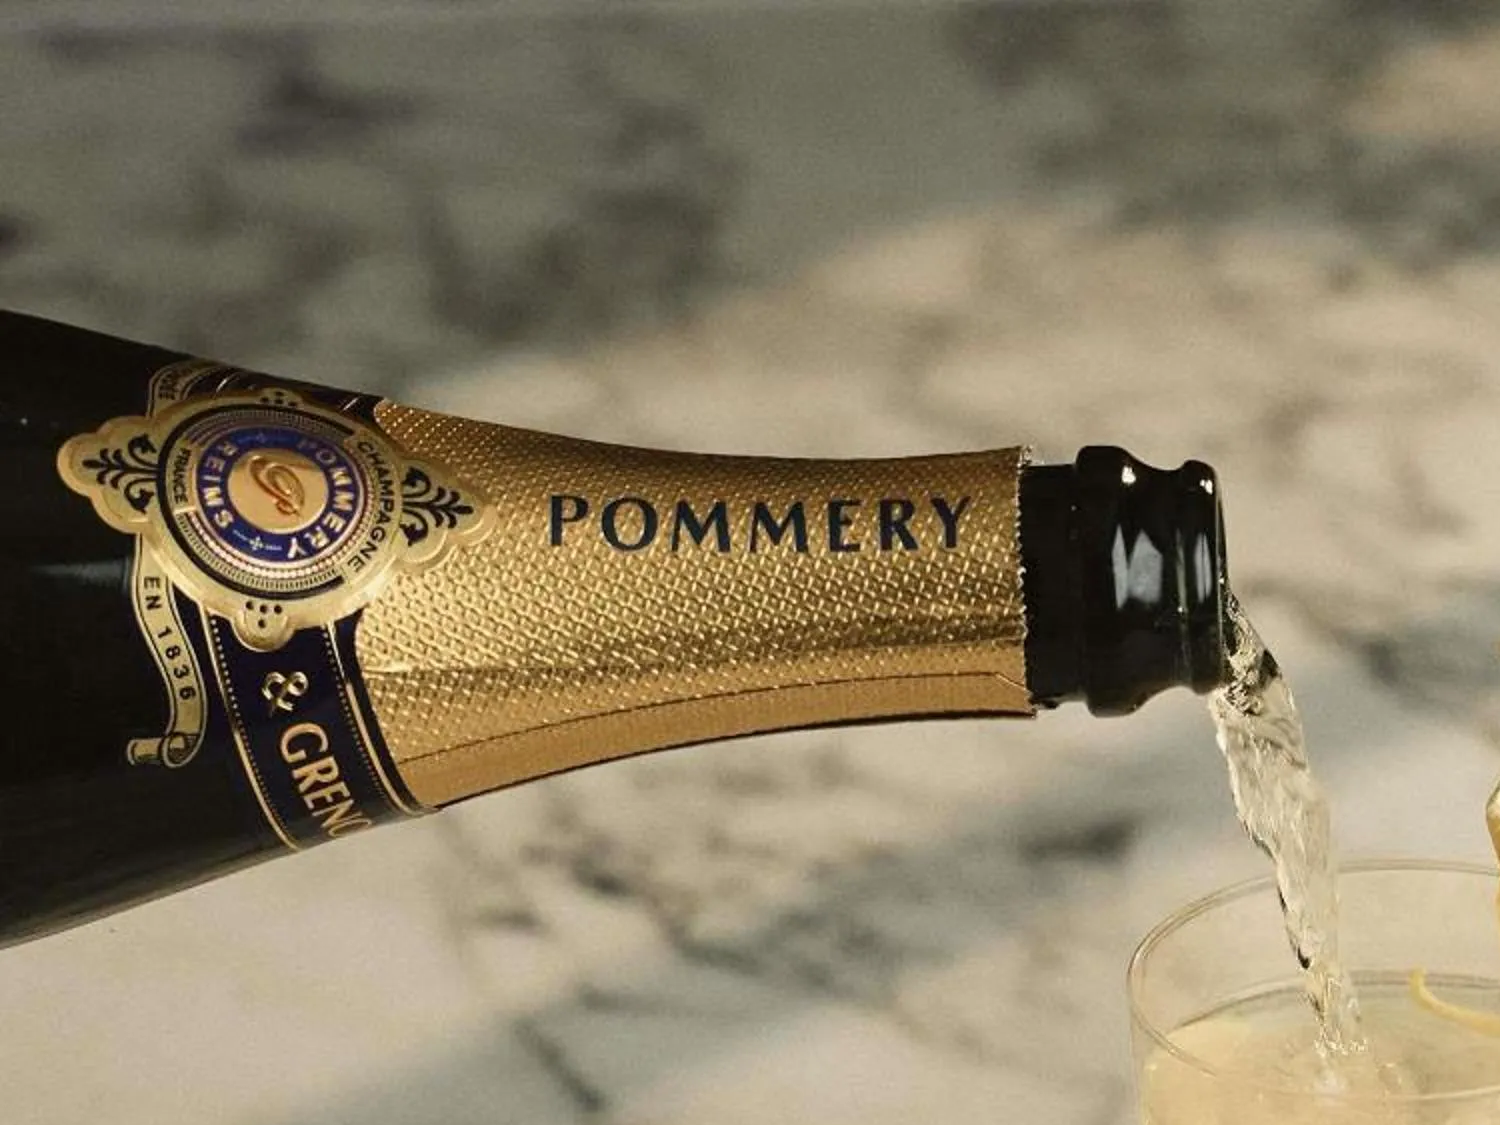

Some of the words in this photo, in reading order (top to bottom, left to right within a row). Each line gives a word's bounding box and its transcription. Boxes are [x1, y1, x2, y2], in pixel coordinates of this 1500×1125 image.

[173, 447, 191, 505] FRANCE
[203, 441, 238, 528] REIMS
[339, 441, 395, 573] CHAMPAGNE
[549, 494, 970, 554] POMMERY
[143, 575, 162, 611] EN
[157, 626, 197, 700] 1836
